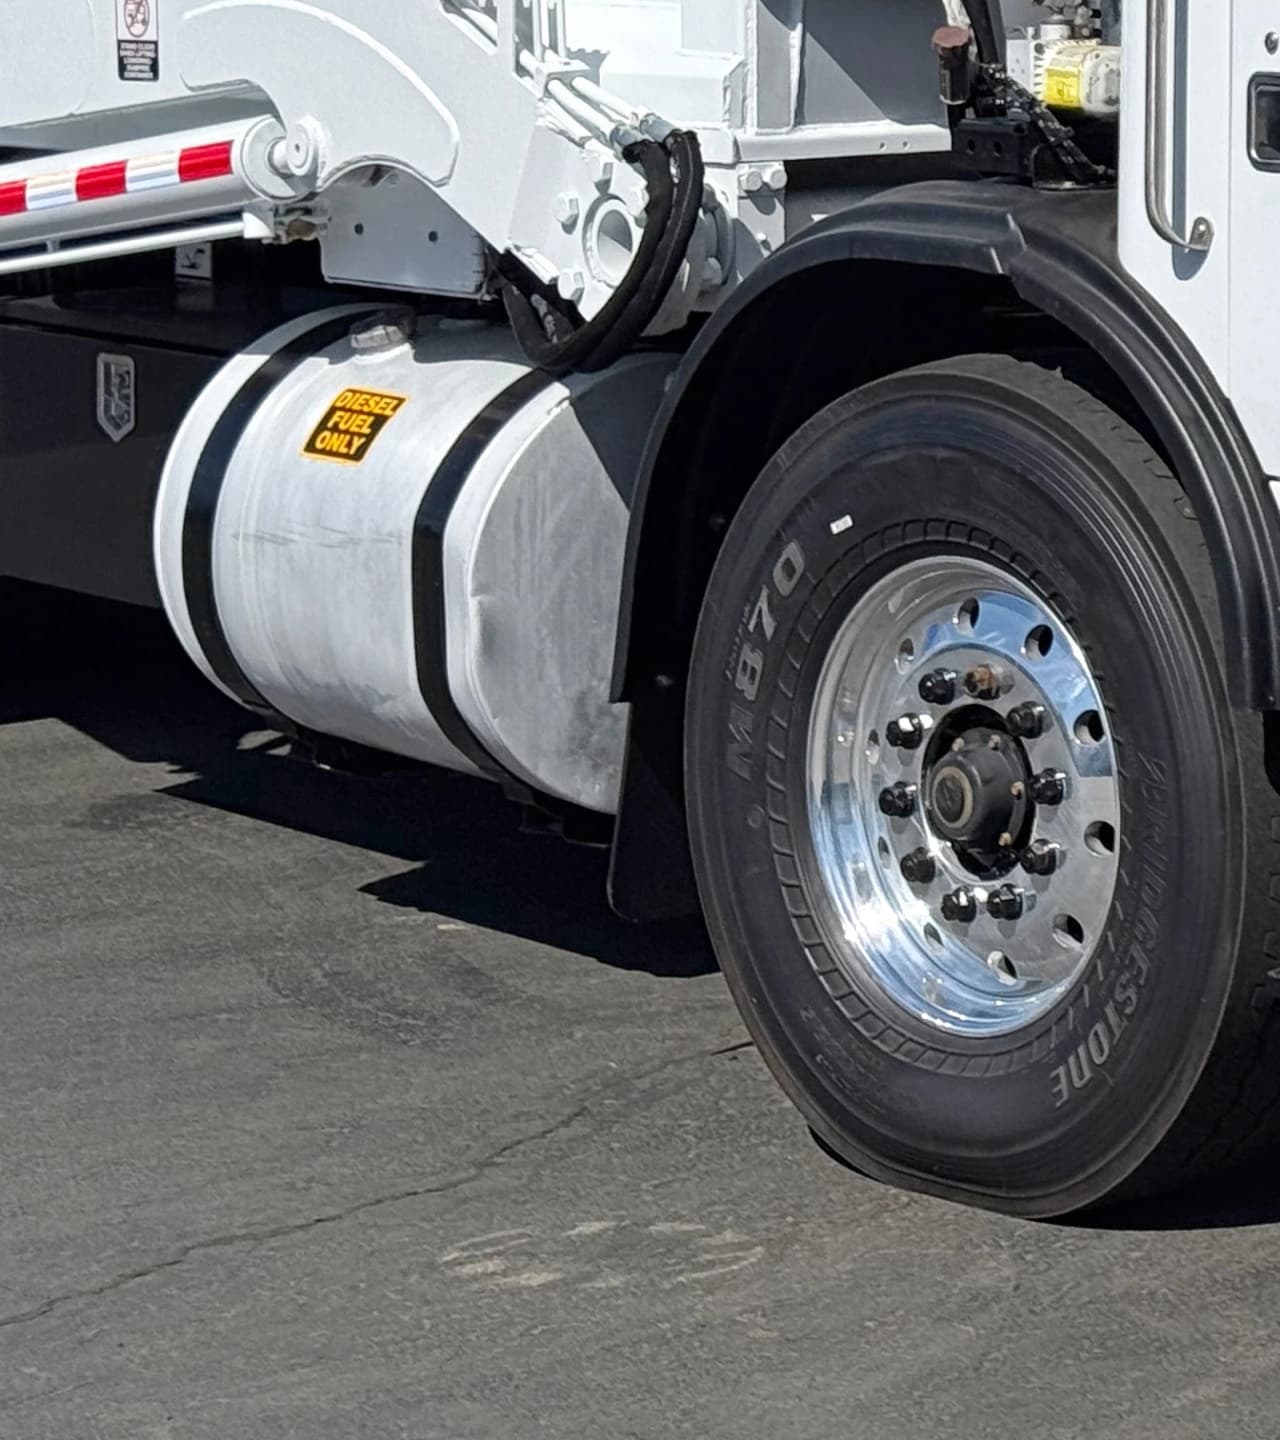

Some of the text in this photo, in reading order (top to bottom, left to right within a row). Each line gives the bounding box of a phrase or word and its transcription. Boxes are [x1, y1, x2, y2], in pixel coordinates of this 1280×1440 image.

[334, 391, 399, 416] DIESEL
[327, 411, 375, 435] FUEL
[314, 430, 367, 455] ONLY
